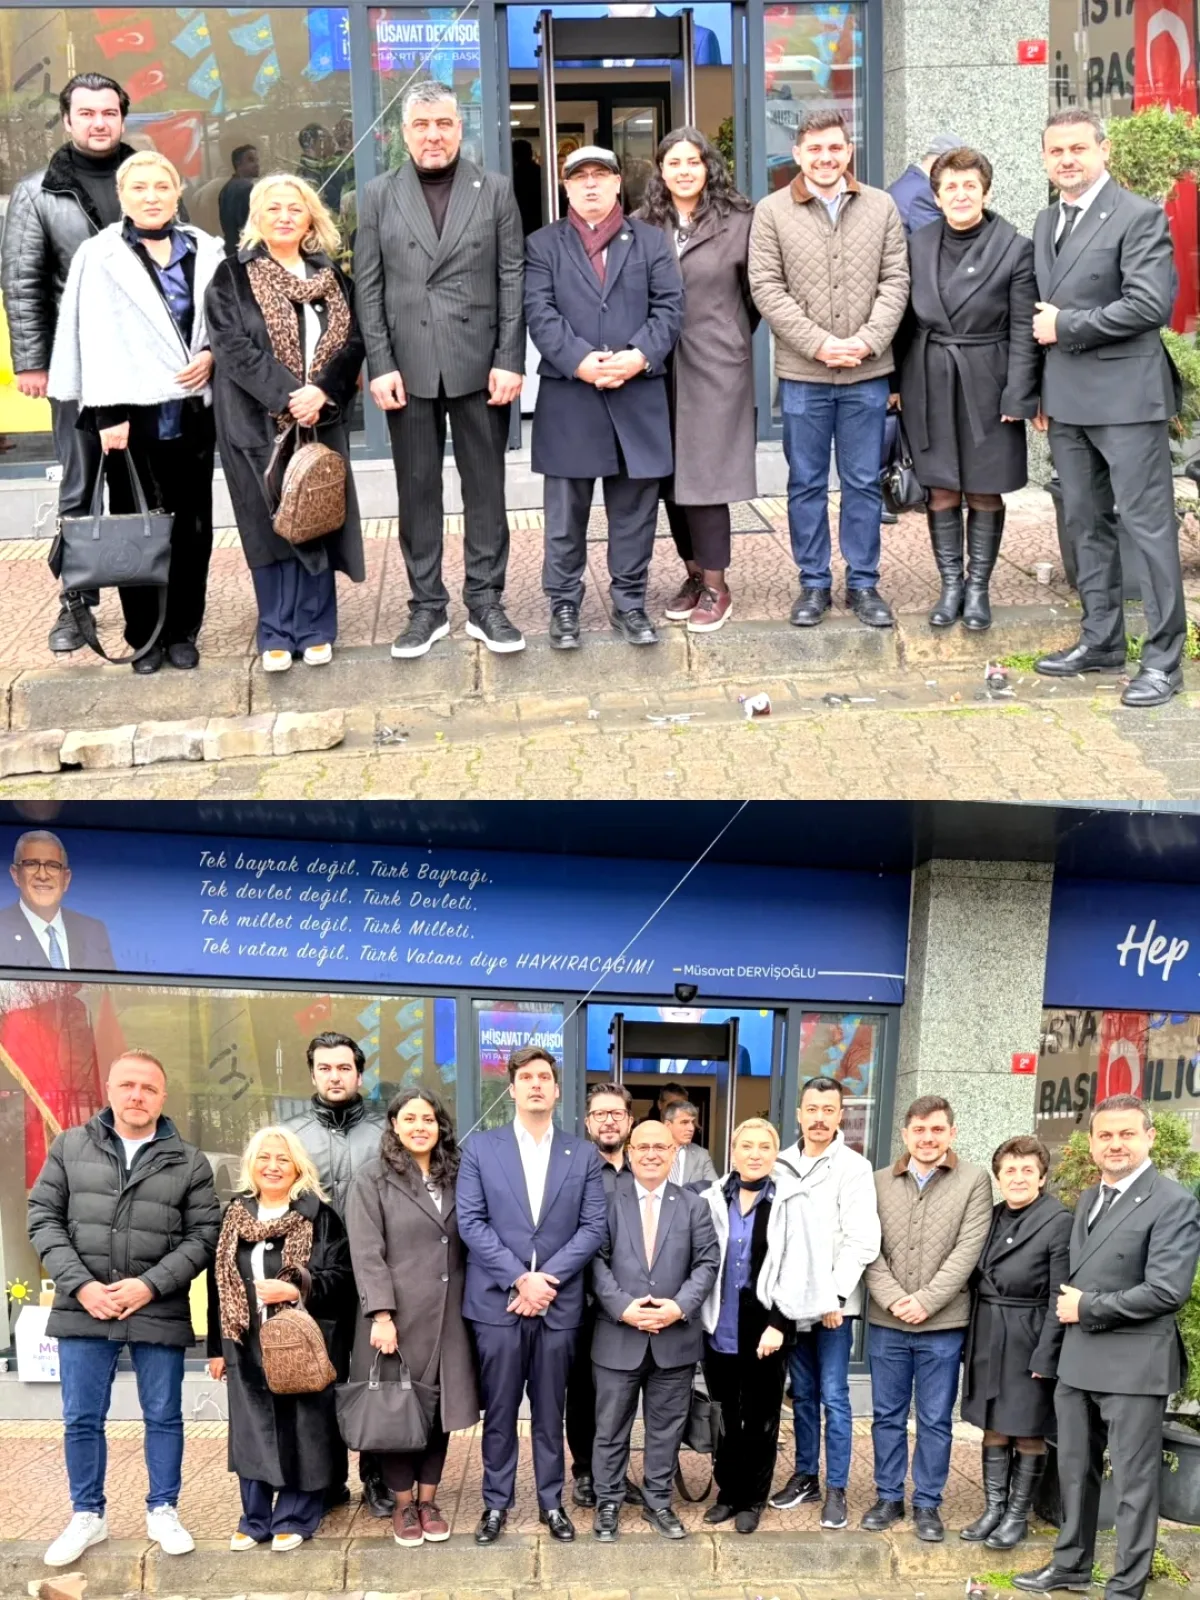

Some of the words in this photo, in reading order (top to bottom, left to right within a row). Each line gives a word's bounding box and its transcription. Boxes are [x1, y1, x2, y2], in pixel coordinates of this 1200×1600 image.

[199, 851, 228, 869] Tek
[235, 852, 300, 879] bayrak
[306, 857, 360, 882] değil.
[370, 860, 410, 878] Türk
[417, 863, 493, 890] Bayrağı.
[200, 880, 229, 898] Tek
[236, 882, 293, 900] devlet
[299, 885, 353, 911] değil.
[363, 888, 402, 906] Türk
[409, 891, 477, 911] Devleti.
[201, 909, 230, 927] Tek
[236, 912, 294, 929] millet
[299, 914, 353, 939] değil.
[363, 917, 402, 935] Türk
[408, 920, 475, 939] Milleti.
[202, 938, 231, 955] Tek
[238, 941, 289, 958] vatan
[296, 942, 350, 967] değil.
[360, 945, 399, 962] Türk
[406, 948, 463, 966] Vatanı
[470, 951, 508, 975] diye
[515, 953, 655, 975] HAYKIRACAĞIM!
[1116, 919, 1190, 981] Hep
[684, 964, 735, 977] Müsavat
[737, 963, 816, 981] DERVİŞOĞLU
